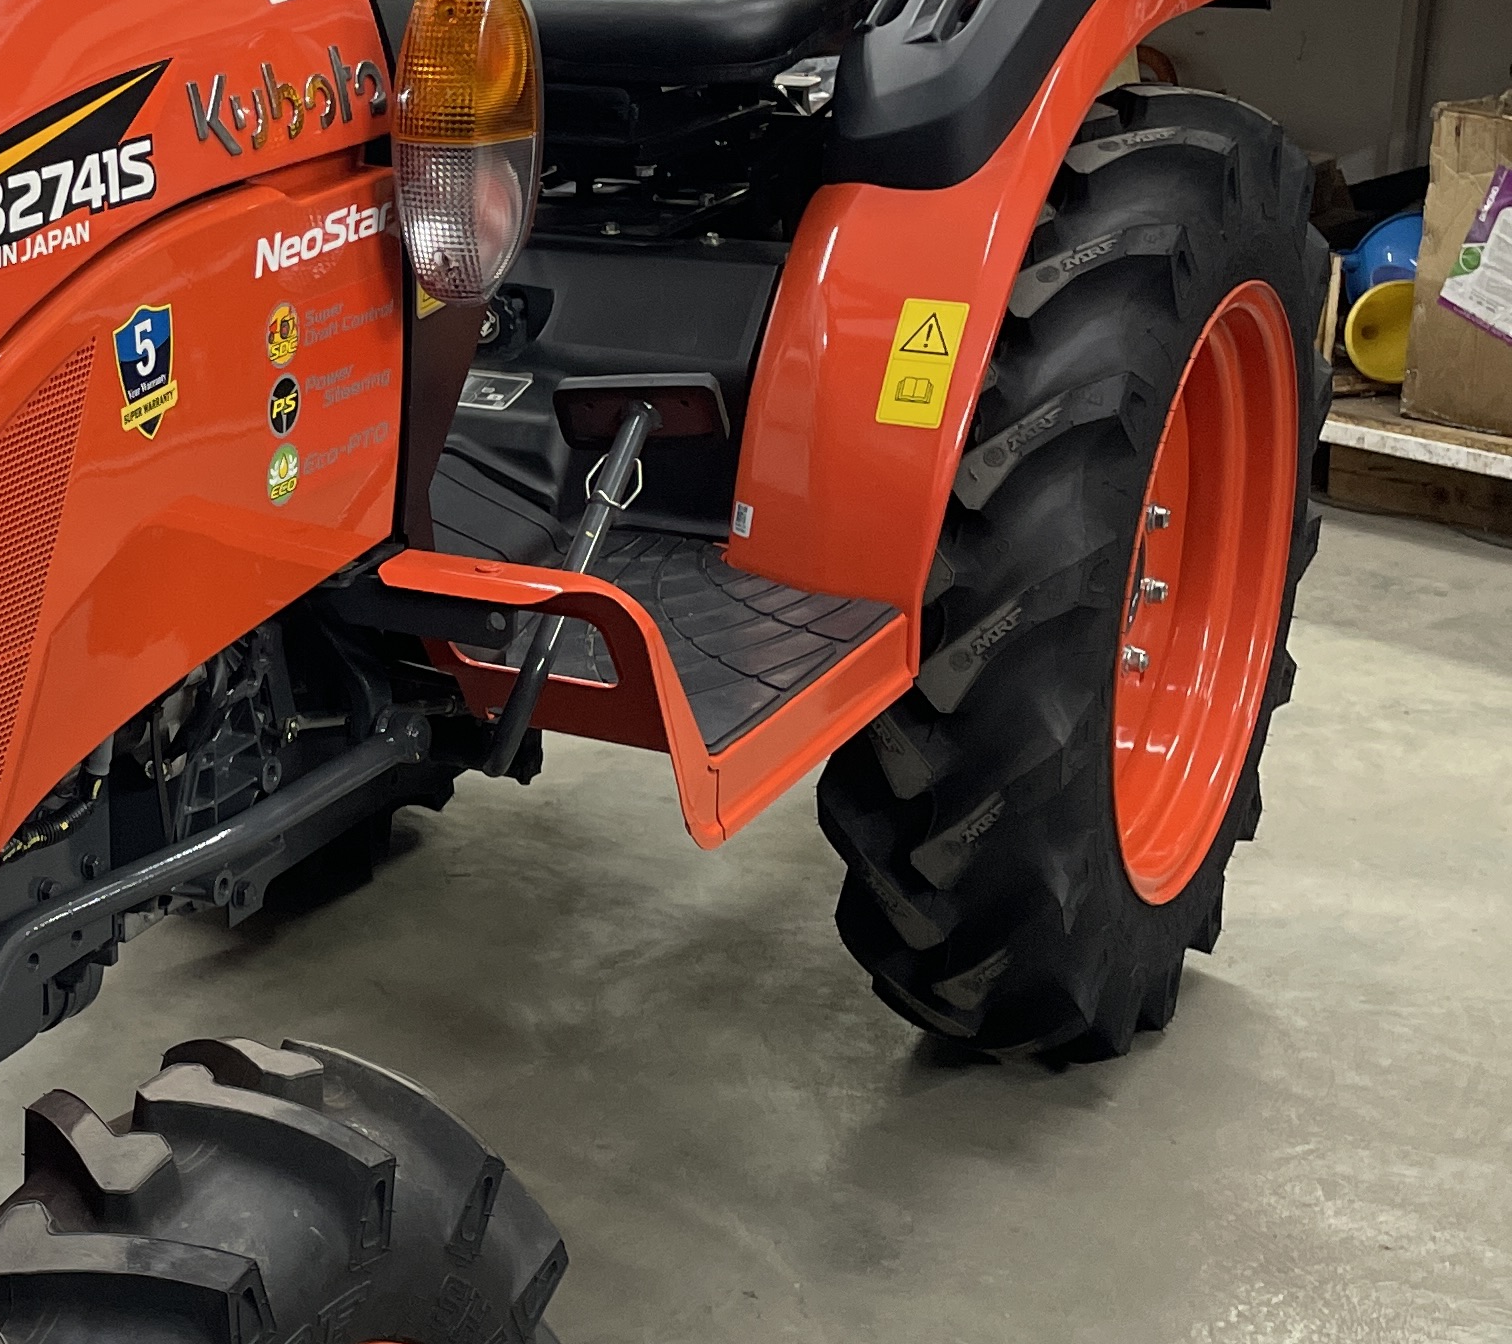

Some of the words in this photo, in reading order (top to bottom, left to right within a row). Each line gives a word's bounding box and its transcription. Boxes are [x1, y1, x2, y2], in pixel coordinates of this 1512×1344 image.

[186, 45, 387, 156] Kubota
[20, 220, 91, 263] JAPAN
[255, 201, 393, 280] NeoStar
[1062, 237, 1119, 273] MRF
[304, 302, 344, 327] Super
[133, 317, 157, 377] 5
[269, 337, 298, 361] SDC
[304, 364, 354, 395] Power
[323, 367, 392, 408] Steering
[124, 406, 143, 425] SUPER
[143, 389, 174, 415] WARRANTY
[272, 392, 297, 419] PS
[1006, 406, 1065, 455] MRF
[270, 477, 298, 500] ECO
[971, 605, 1023, 655] MRF
